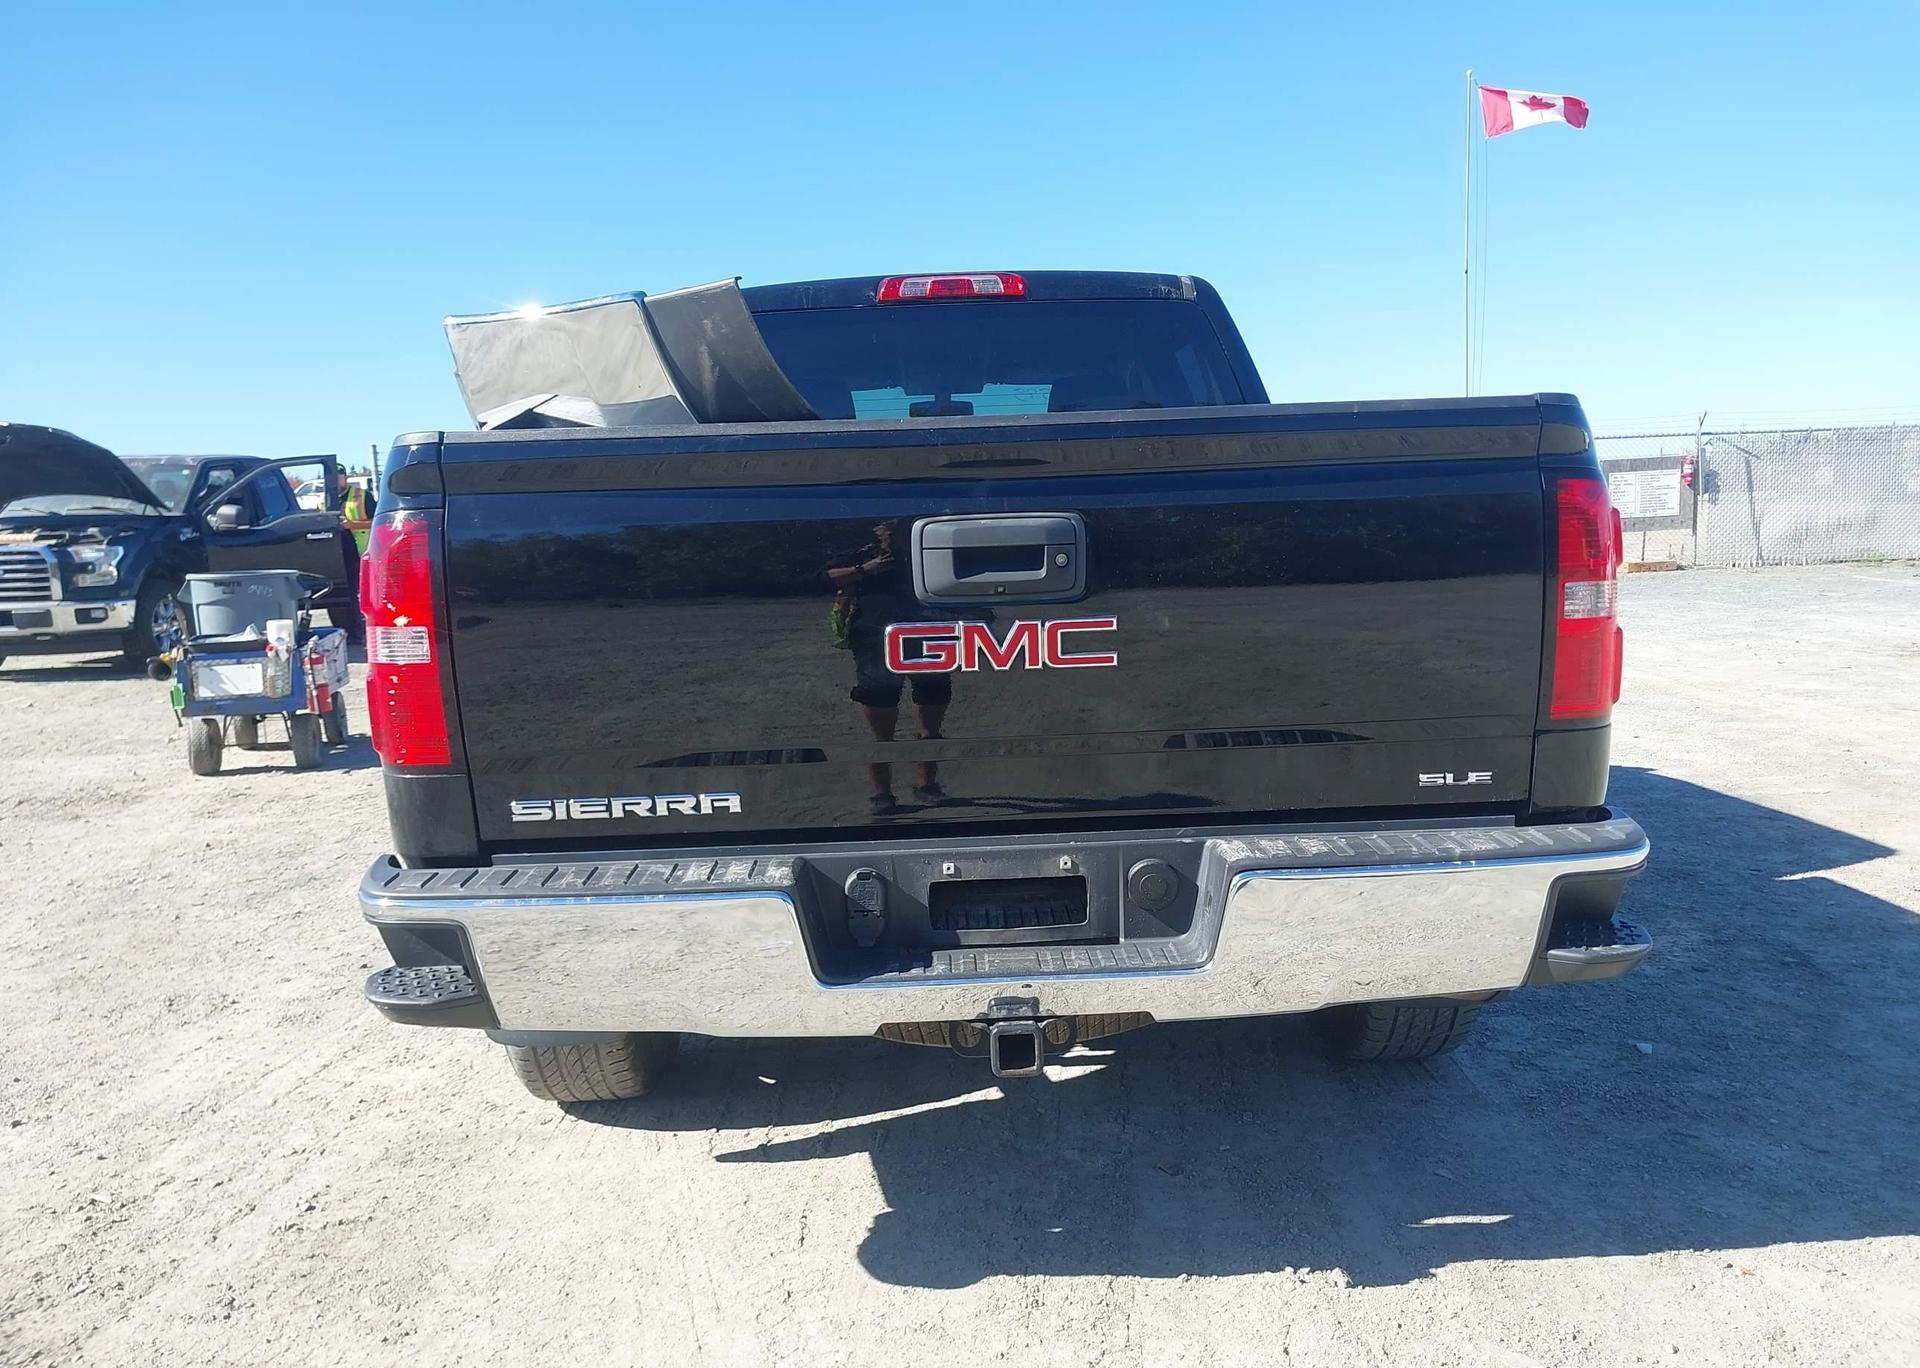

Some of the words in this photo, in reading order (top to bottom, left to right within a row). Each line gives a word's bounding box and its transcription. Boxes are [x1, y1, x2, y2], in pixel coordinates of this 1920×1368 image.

[885, 615, 1118, 674] GMC
[1419, 771, 1493, 787] SLE
[510, 792, 742, 822] SIERRA
